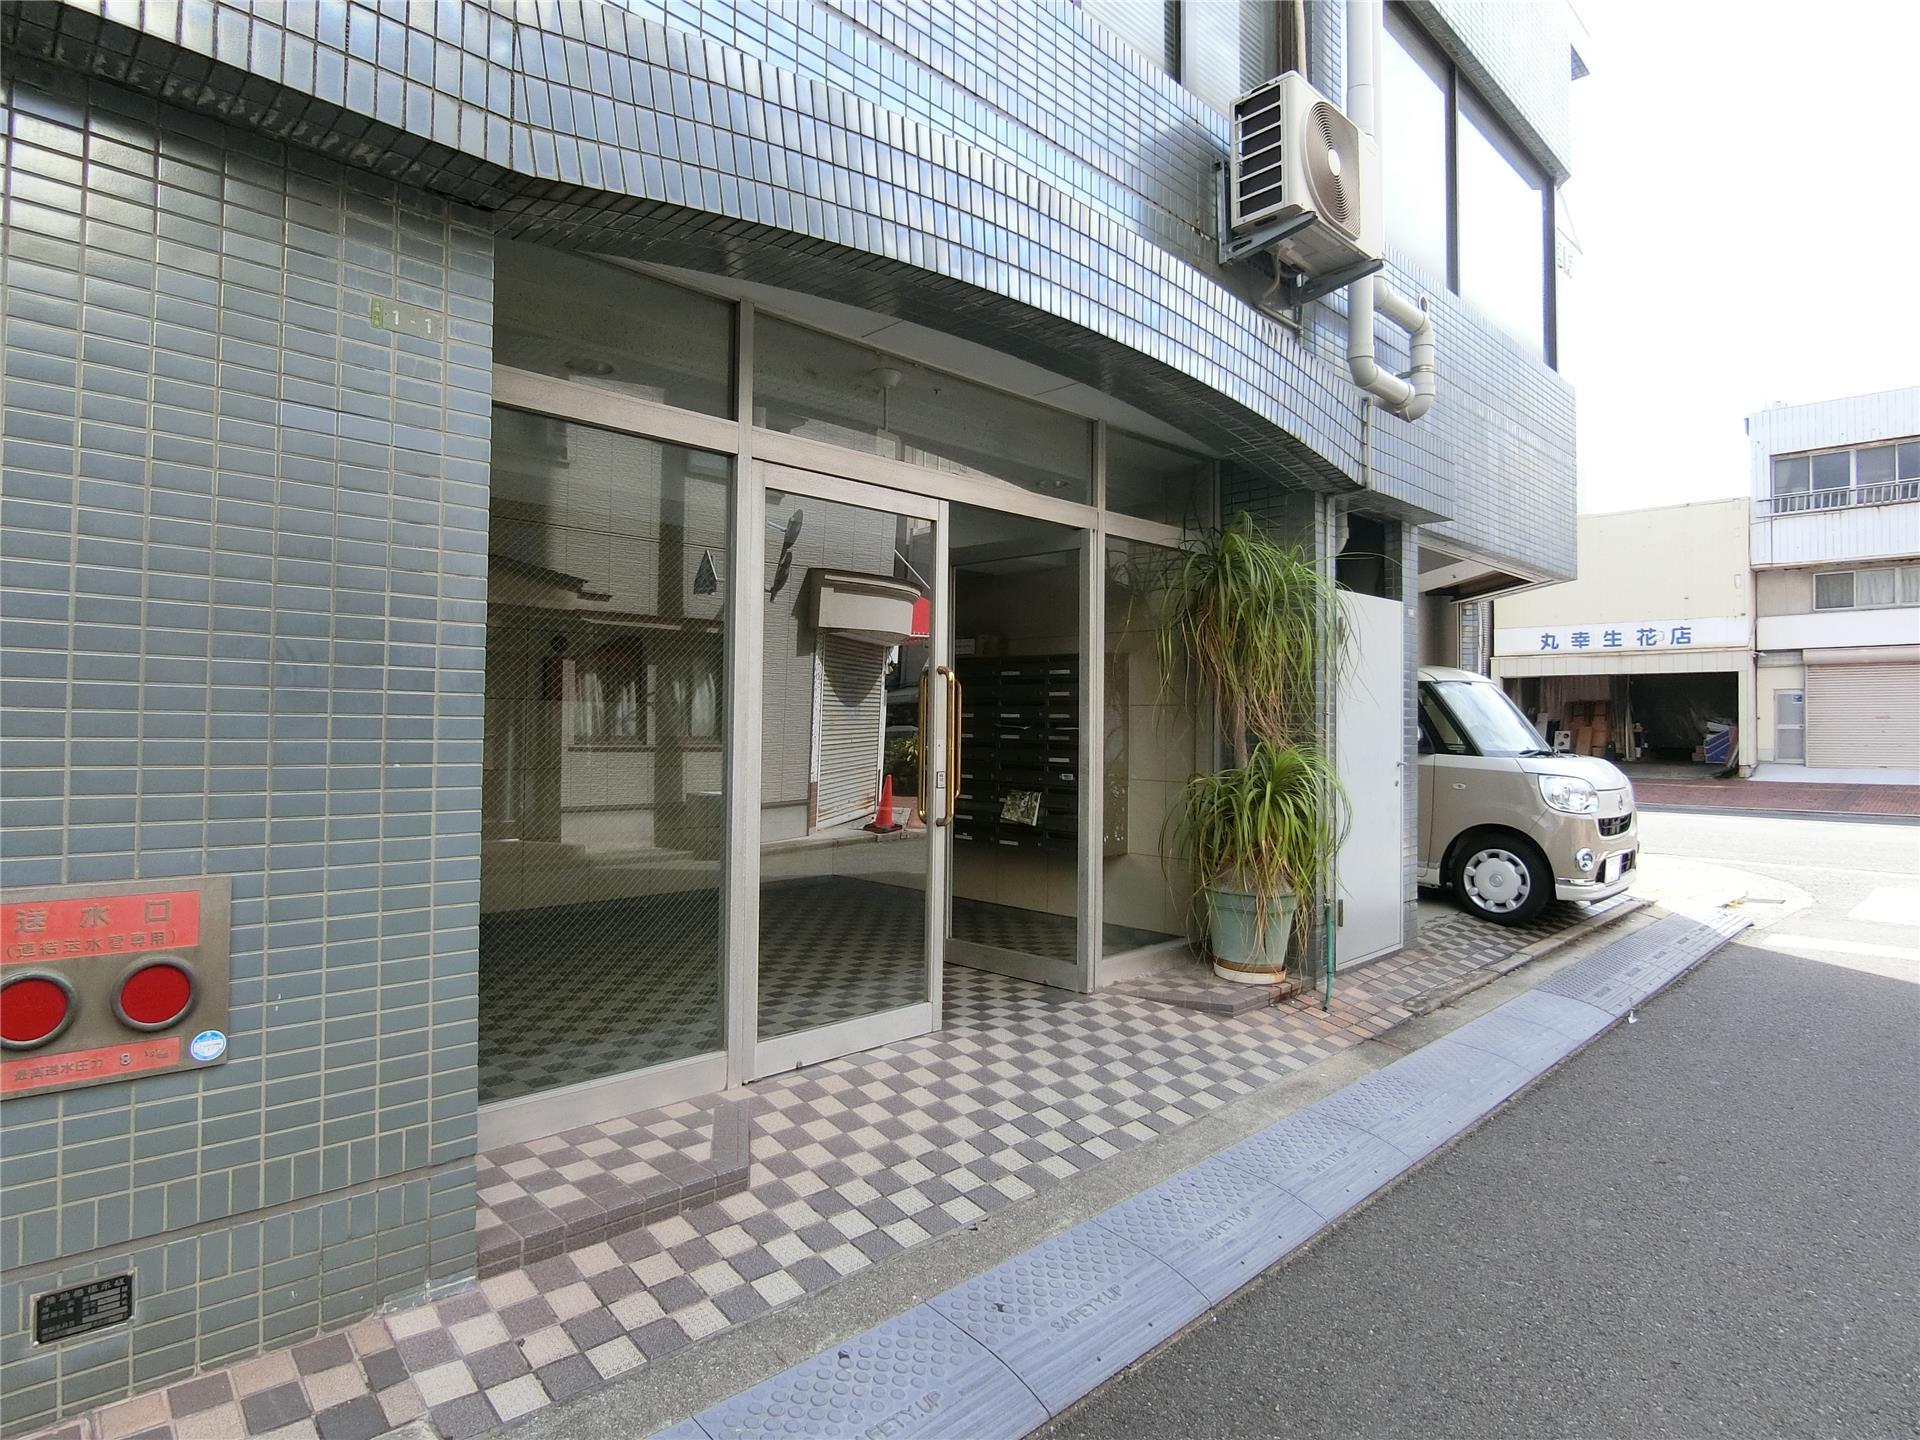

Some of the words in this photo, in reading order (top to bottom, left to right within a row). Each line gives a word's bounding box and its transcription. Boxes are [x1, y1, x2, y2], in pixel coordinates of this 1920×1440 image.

[1540, 626, 1692, 651] 丸幸生花店
[15, 899, 172, 933] 送水口
